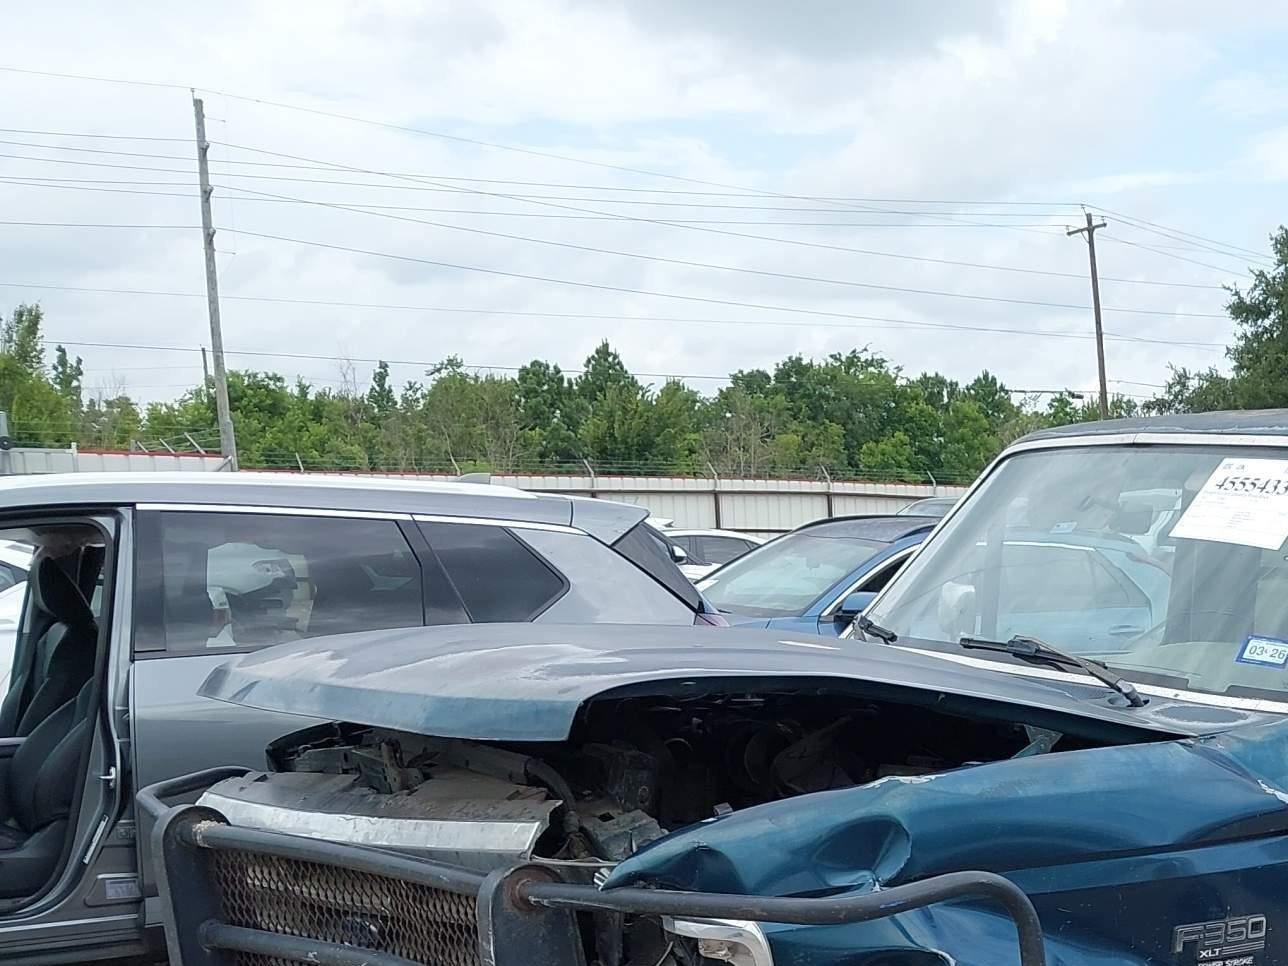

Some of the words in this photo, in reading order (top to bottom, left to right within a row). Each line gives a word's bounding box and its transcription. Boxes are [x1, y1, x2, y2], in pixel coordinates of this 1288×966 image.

[1249, 645, 1265, 656] 03
[1269, 648, 1287, 660] 26
[1199, 948, 1222, 959] XLT
